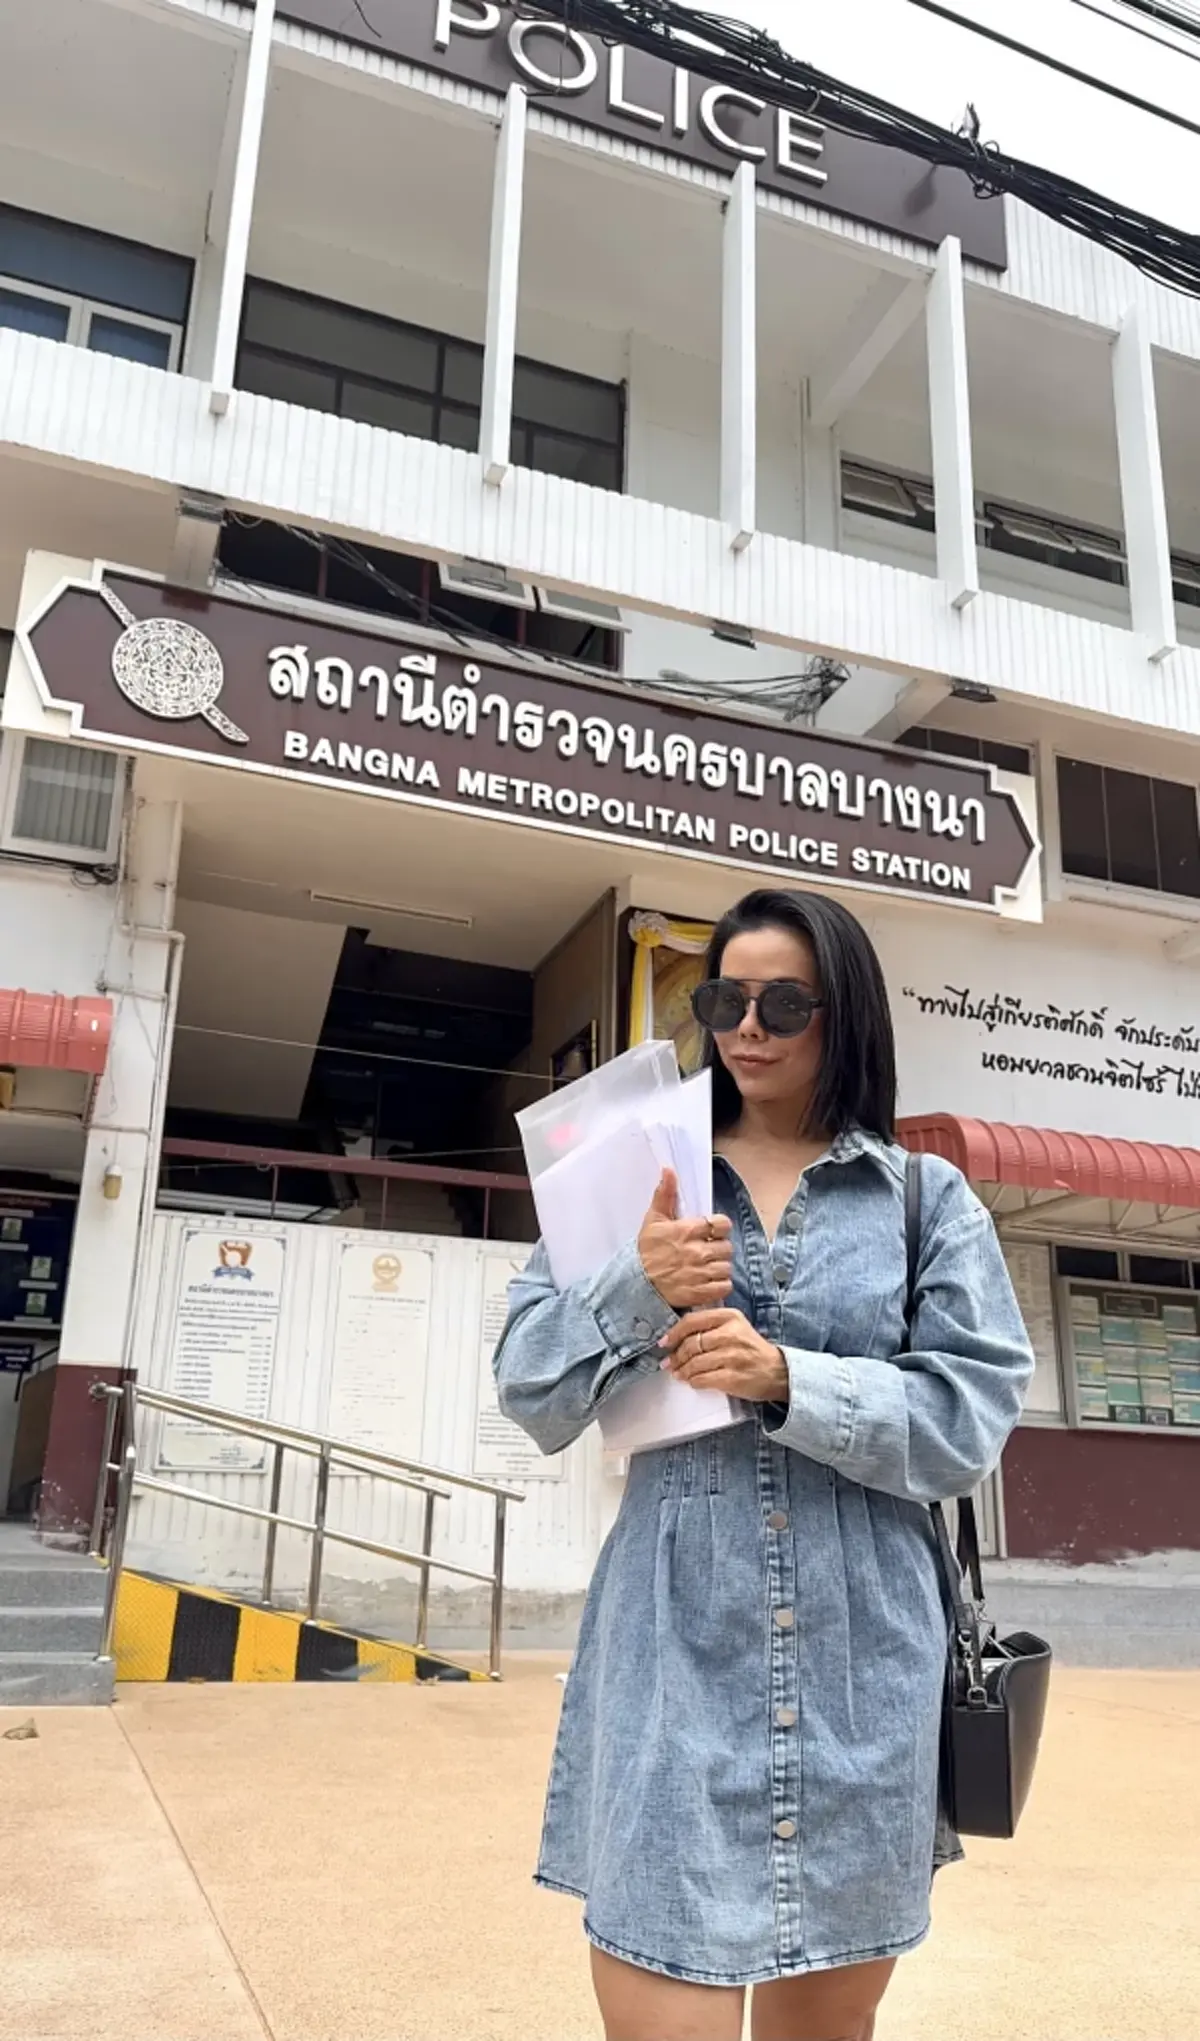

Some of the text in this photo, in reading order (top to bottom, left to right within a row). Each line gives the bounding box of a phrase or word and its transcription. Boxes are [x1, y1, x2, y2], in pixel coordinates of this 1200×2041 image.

[433, 0, 829, 186] POLICE
[268, 644, 986, 843] สถานีตำรวจนครบาลบางนา
[283, 730, 972, 891] BANGNA METROPOLITAN POLICE STATION
